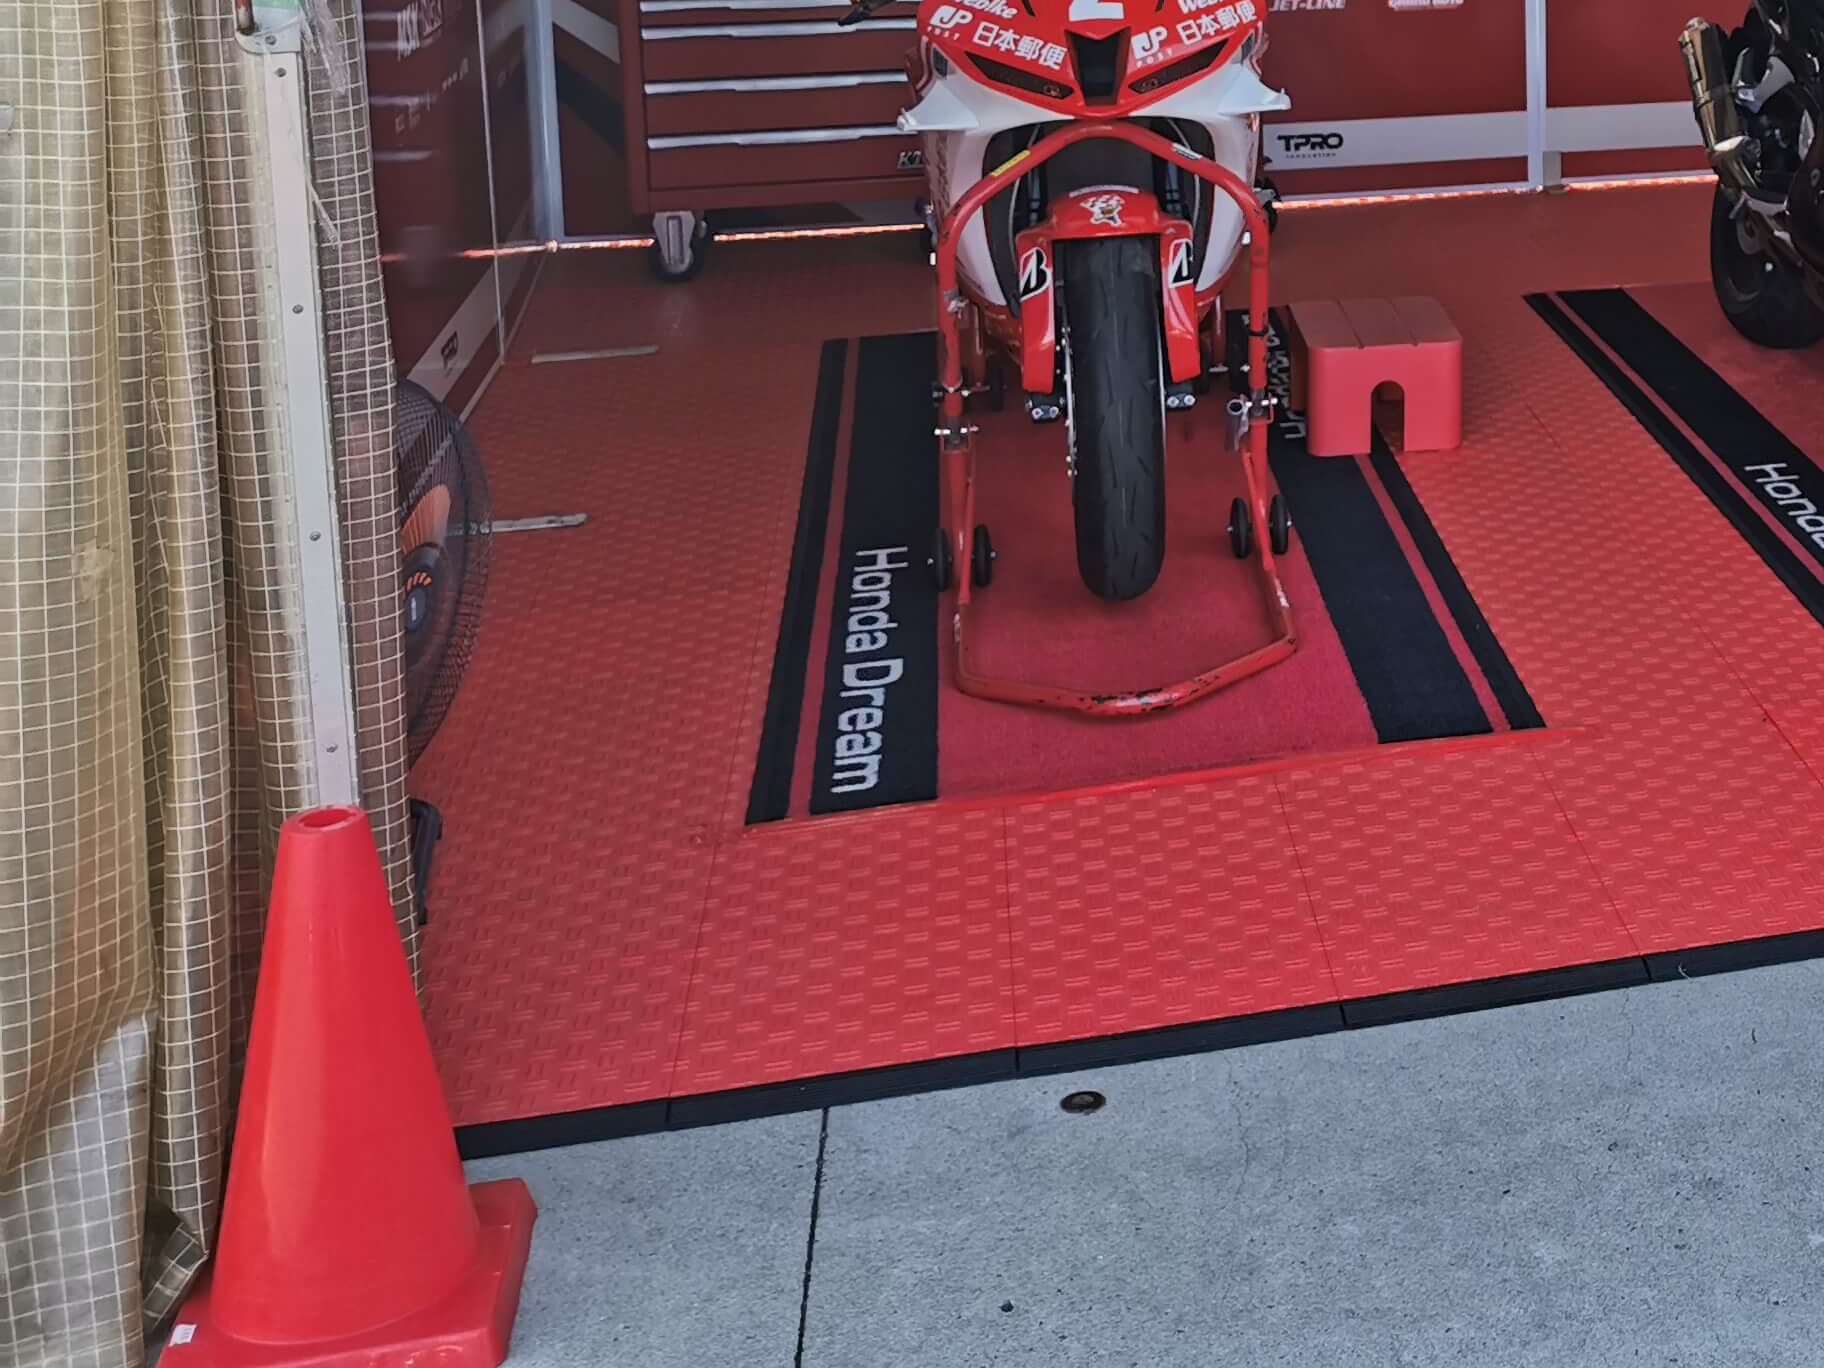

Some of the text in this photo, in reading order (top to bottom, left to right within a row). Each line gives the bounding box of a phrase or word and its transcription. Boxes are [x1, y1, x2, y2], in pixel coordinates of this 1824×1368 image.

[972, 21, 1068, 71] 日本郵便
[1277, 133, 1343, 152] TPRO
[830, 546, 908, 794] Honda Dream
